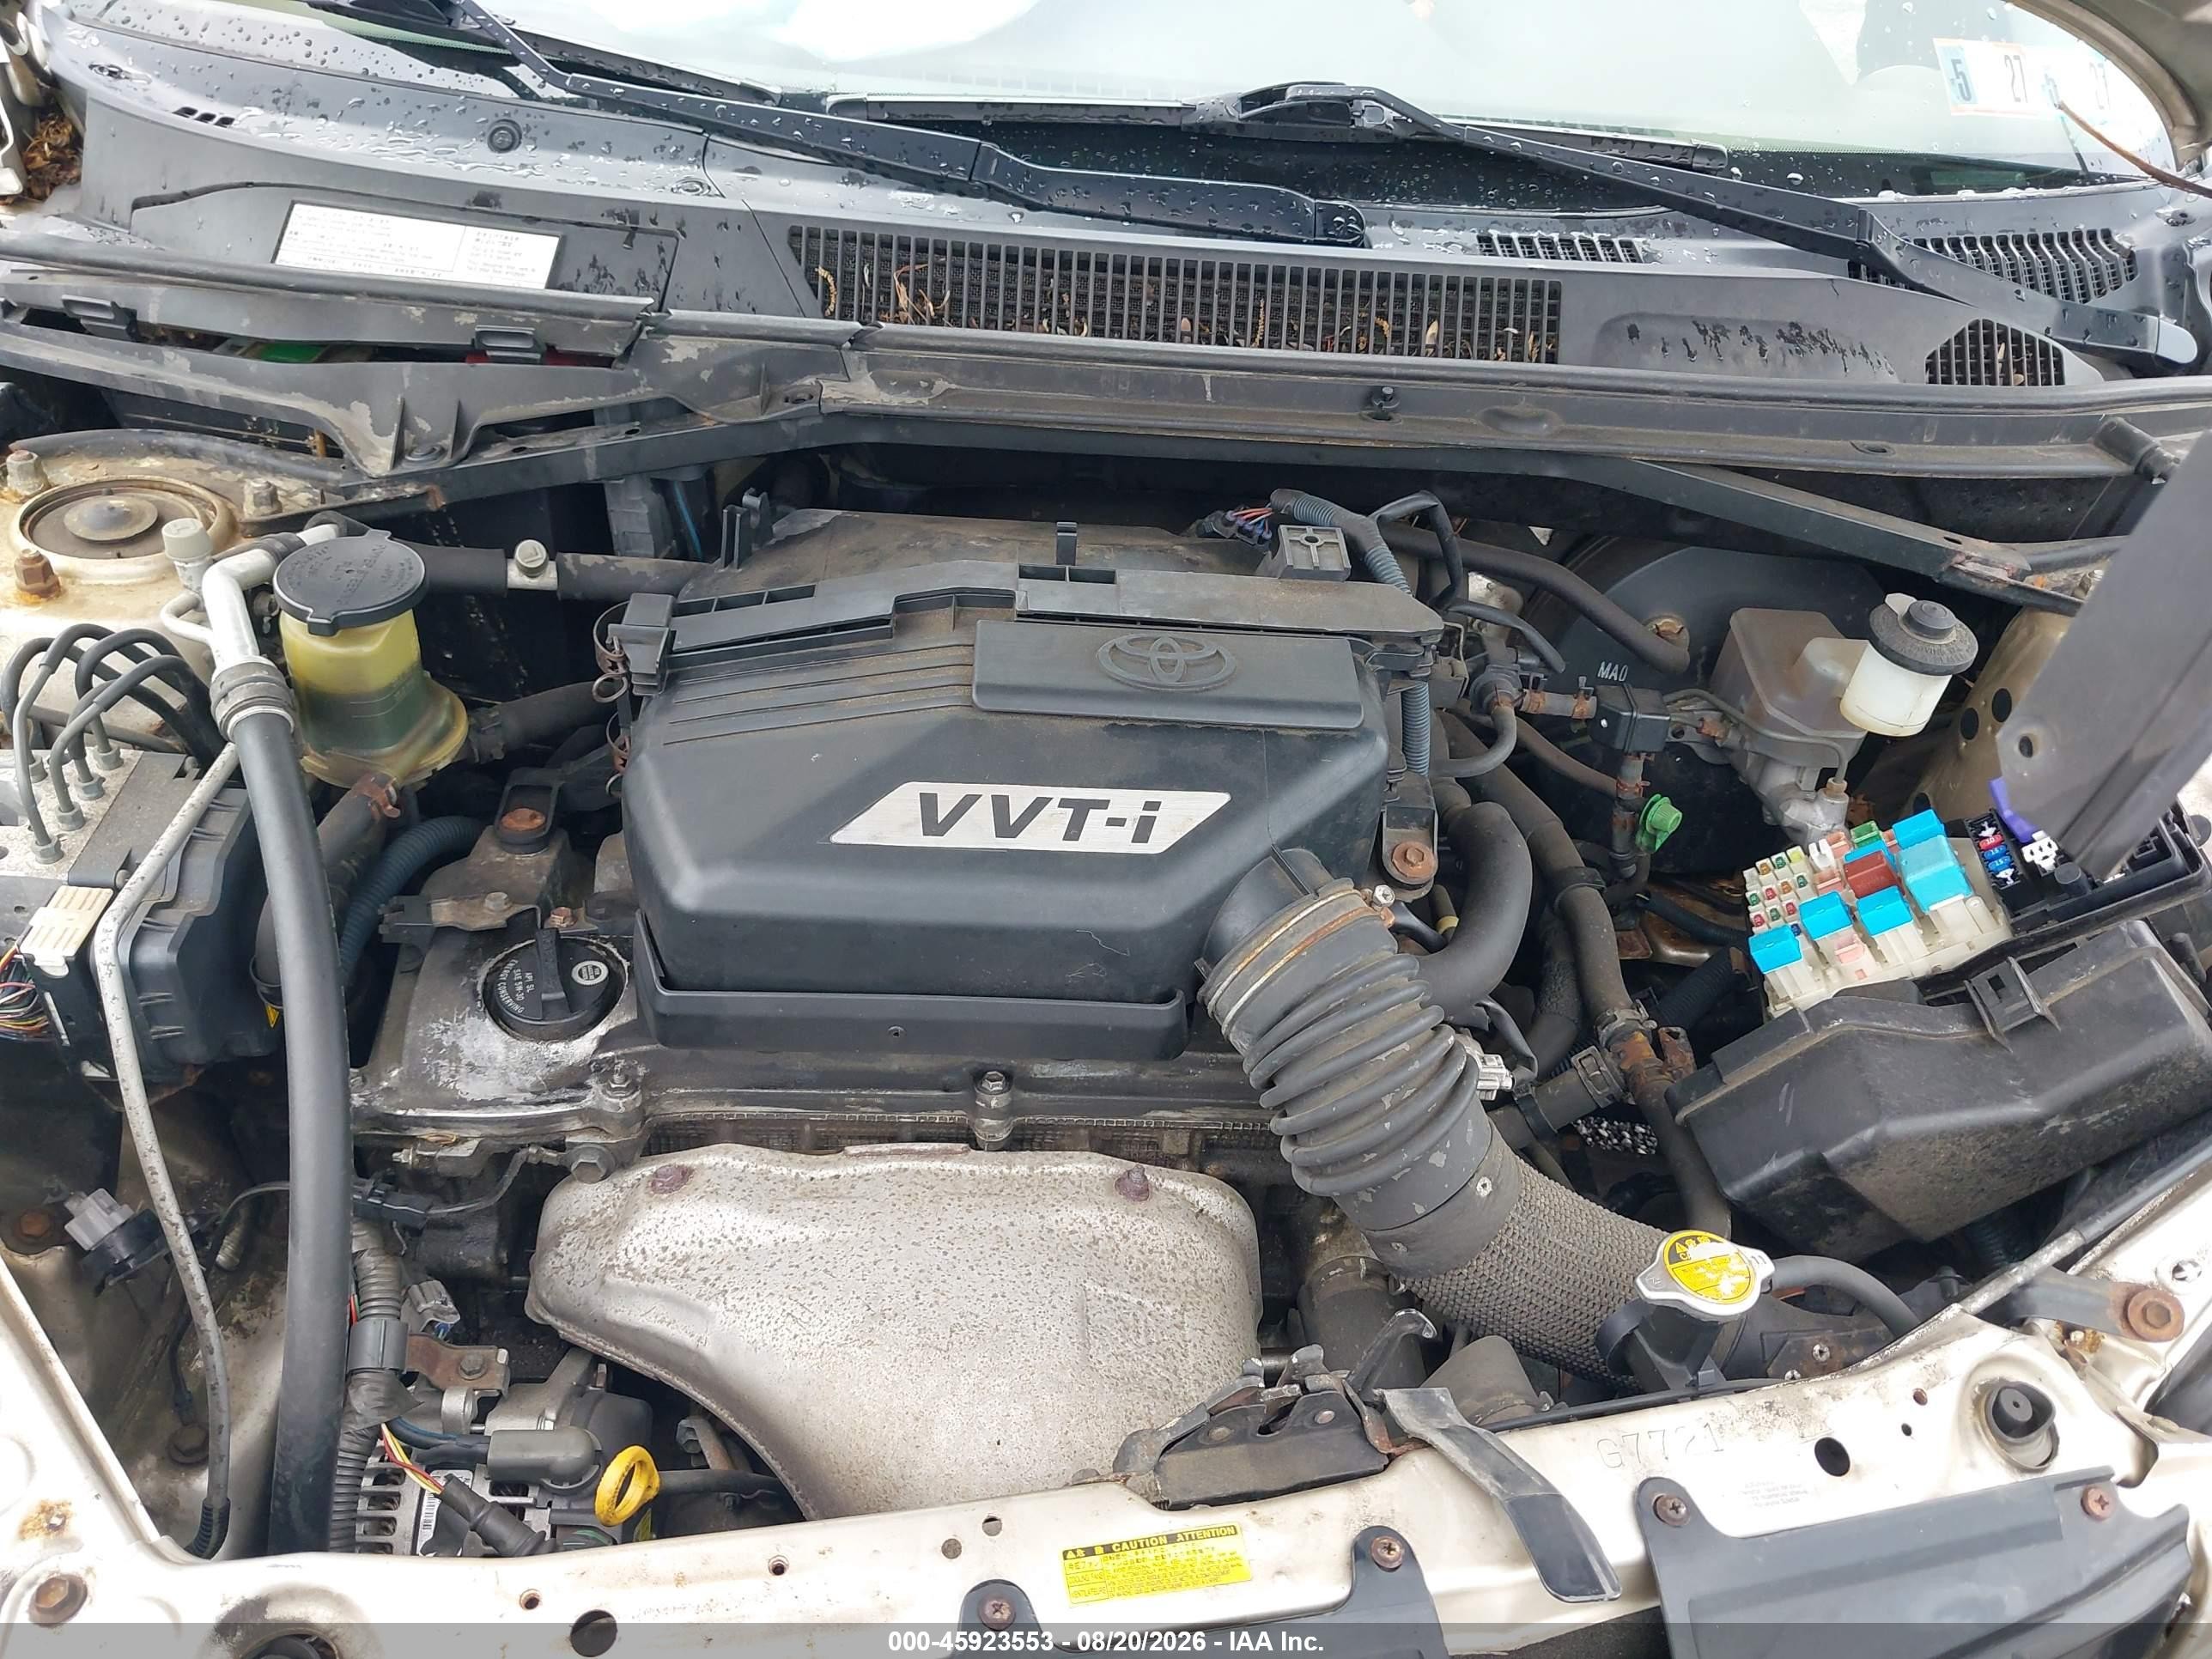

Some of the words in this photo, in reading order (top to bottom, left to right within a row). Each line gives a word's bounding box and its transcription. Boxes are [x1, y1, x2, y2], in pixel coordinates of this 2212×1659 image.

[1950, 58, 1972, 102] 5
[2003, 55, 2028, 103] 27
[919, 792, 1161, 844] VVT-i
[497, 982, 525, 1013] CONSERVING
[526, 983, 535, 994] SL
[1112, 1535, 1168, 1553] CAUTION
[1176, 1526, 1236, 1542] ATTENTION
